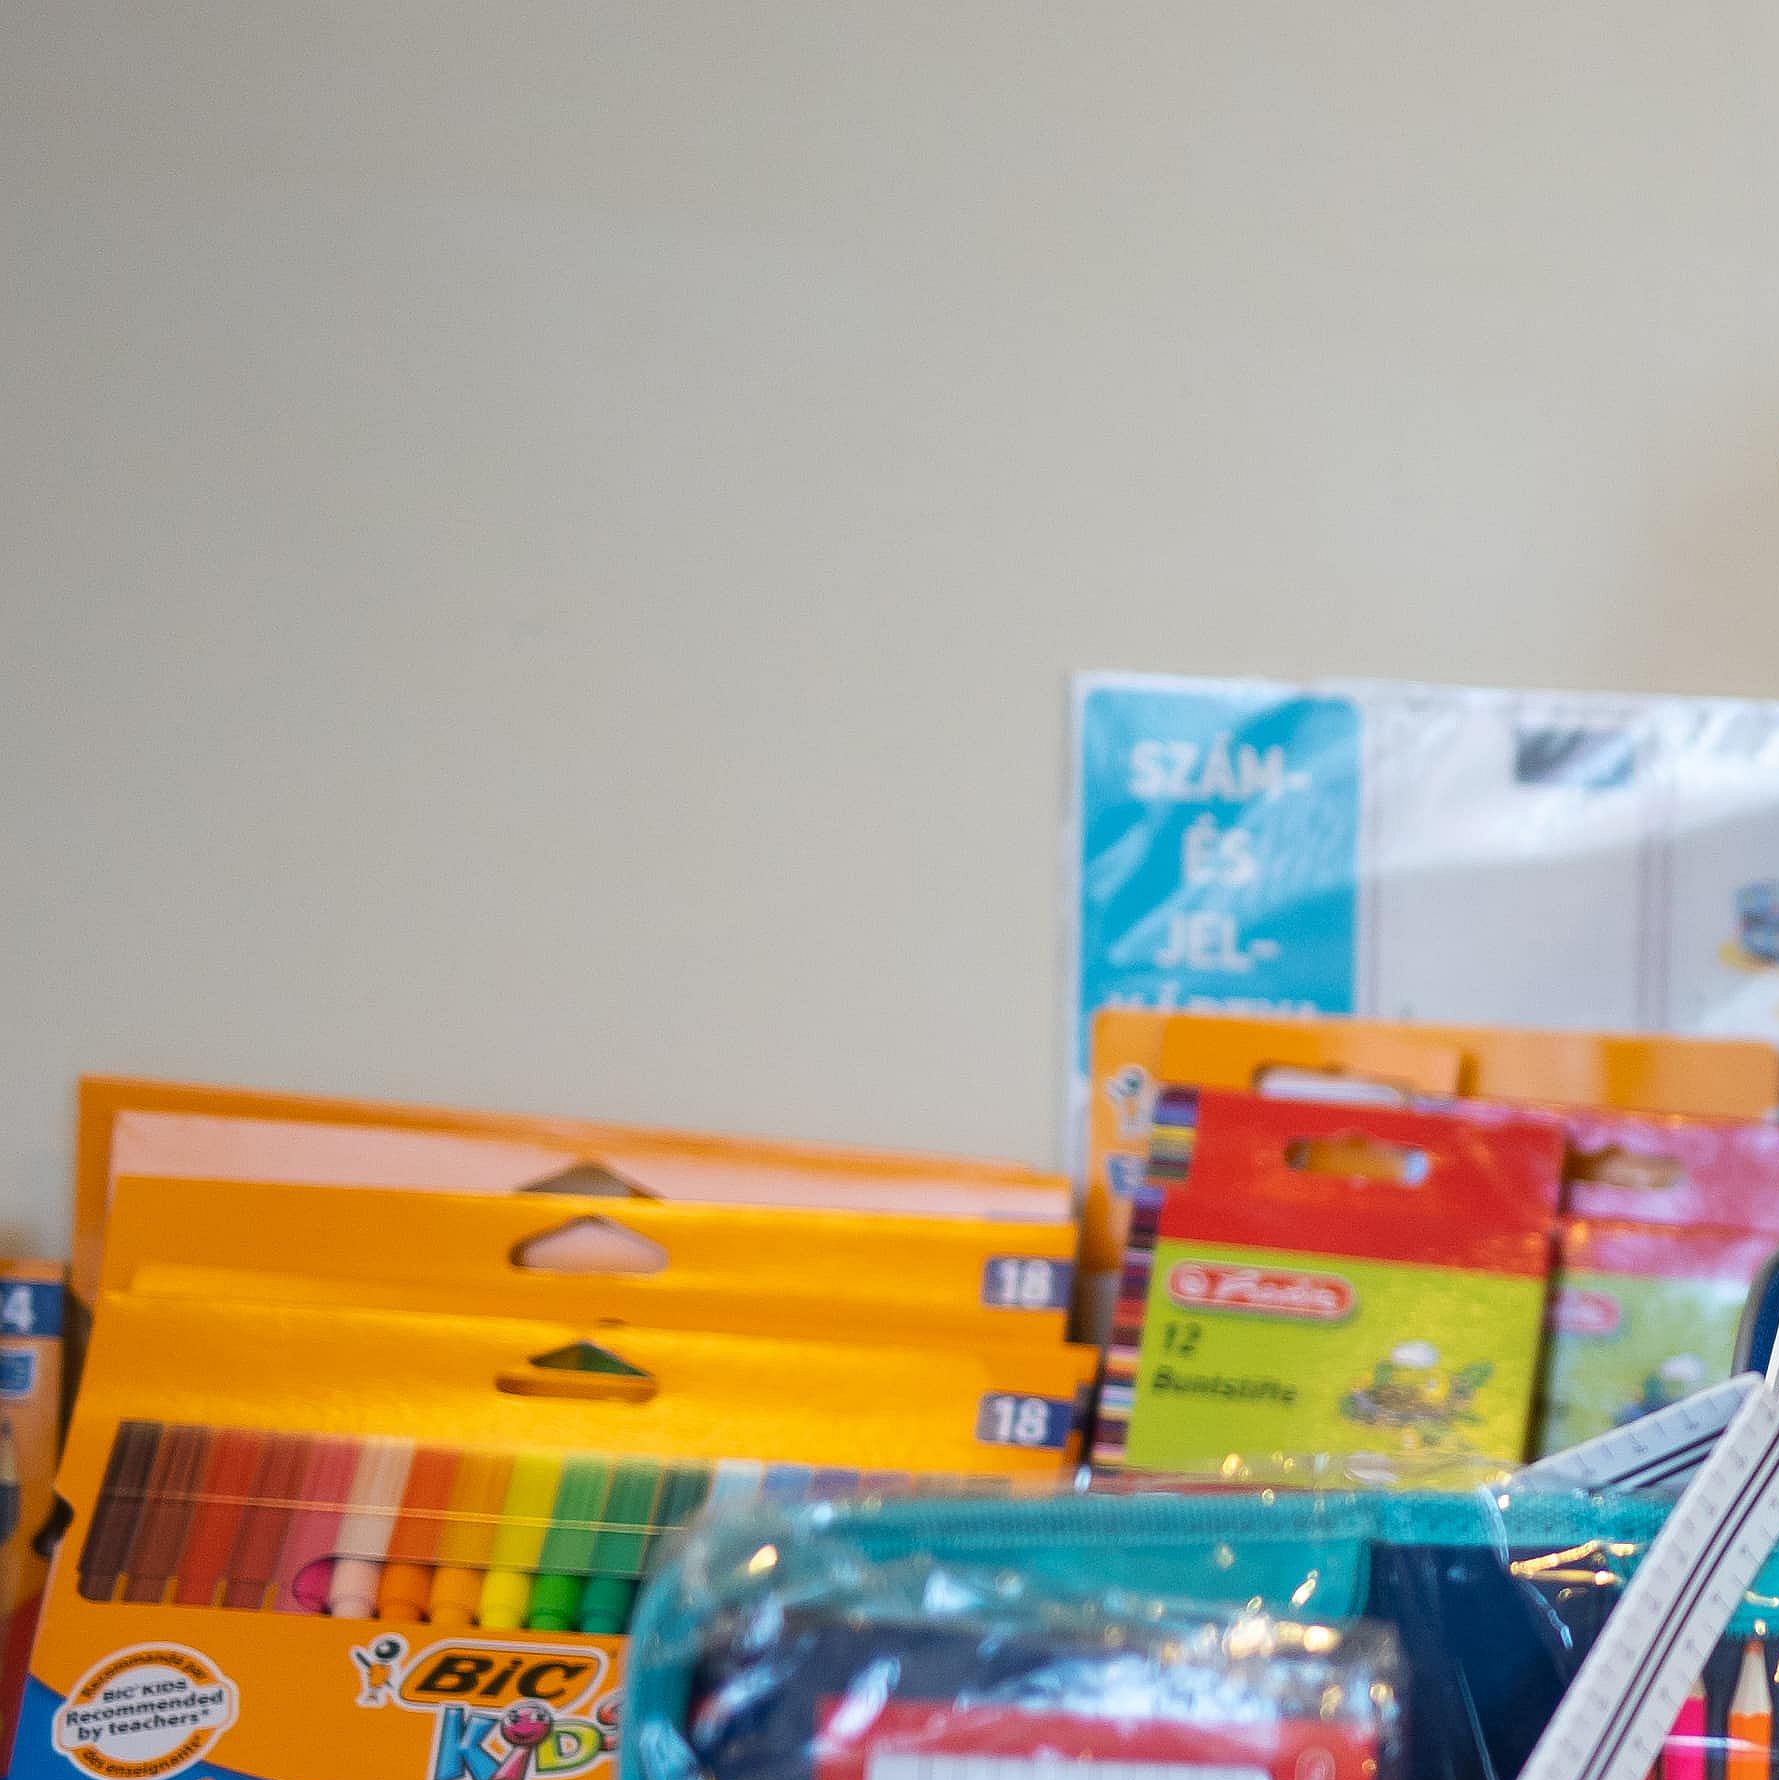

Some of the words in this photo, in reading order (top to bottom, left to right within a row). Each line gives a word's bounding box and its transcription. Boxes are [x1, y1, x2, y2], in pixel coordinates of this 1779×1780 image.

[1128, 728, 1312, 802] SZÁM-
[1183, 810, 1259, 888] ÉS
[994, 1395, 1049, 1442] 18
[65, 1688, 224, 1728] Recommended
[77, 1726, 103, 1742] by
